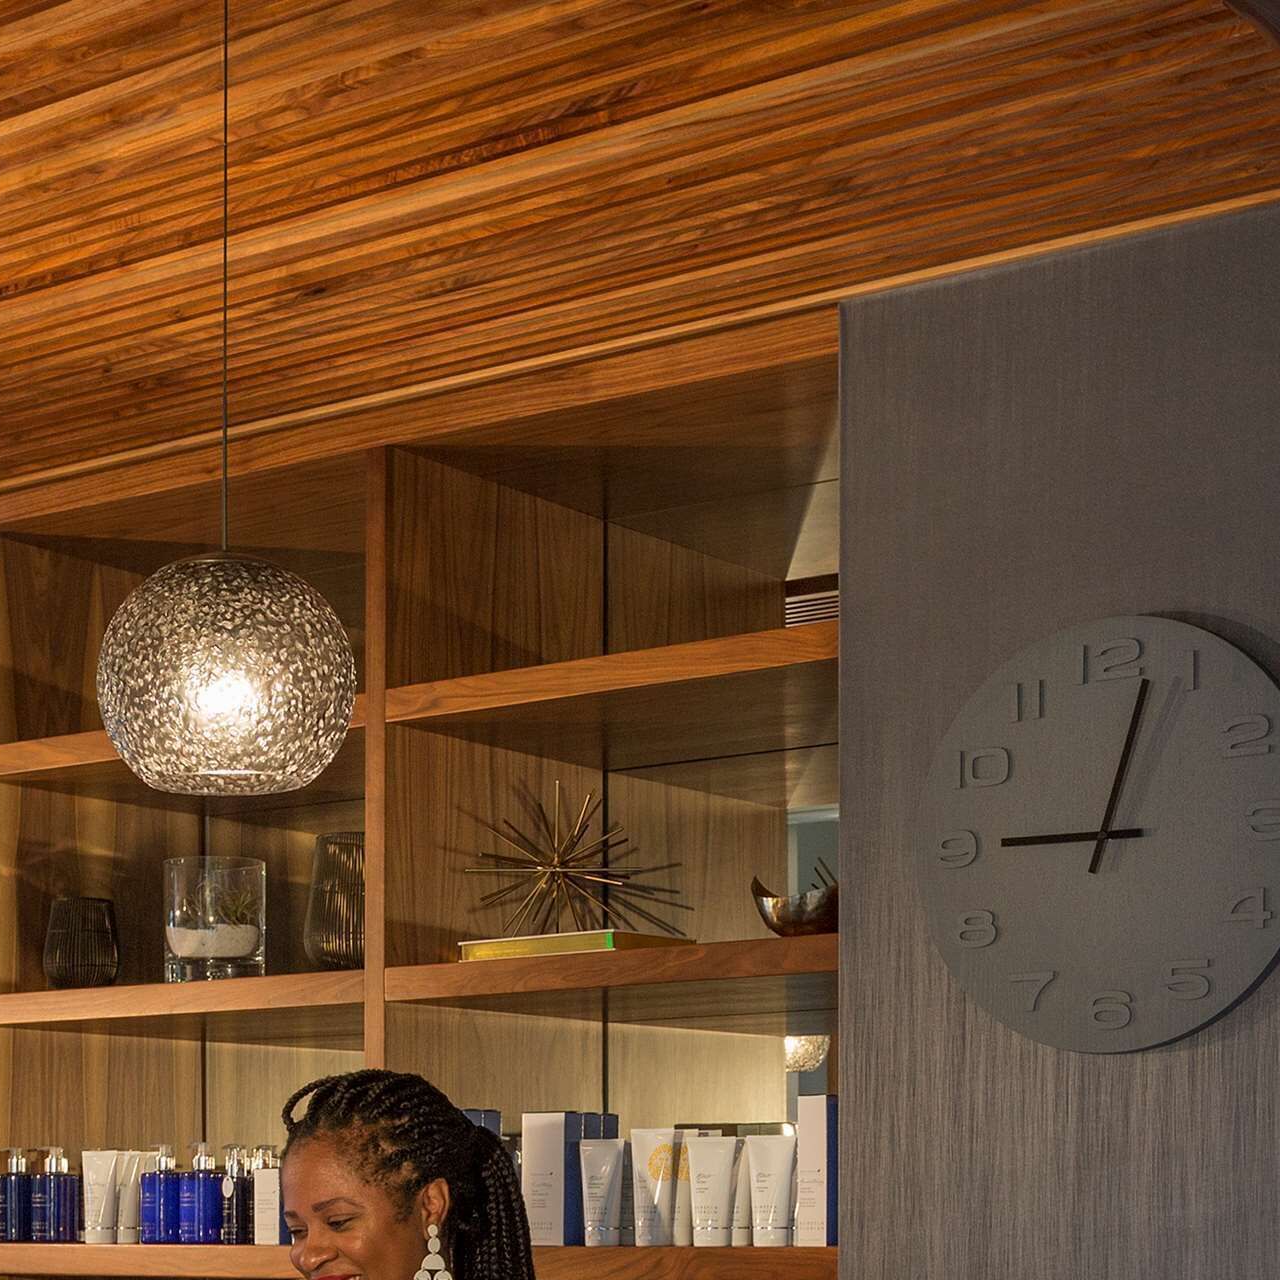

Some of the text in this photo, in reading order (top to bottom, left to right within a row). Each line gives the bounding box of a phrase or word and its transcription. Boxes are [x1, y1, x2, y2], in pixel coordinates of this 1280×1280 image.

[1076, 637, 1145, 686] 12
[1184, 649, 1200, 692] 1
[1009, 679, 1045, 723] 11
[1222, 713, 1273, 759] 2
[954, 746, 1012, 790] 10
[937, 828, 979, 869] 9
[958, 909, 999, 950] 8
[1222, 887, 1274, 930] 4
[1009, 970, 1059, 1014] 7
[1161, 958, 1213, 1001] 5
[1091, 989, 1134, 1031] 6
